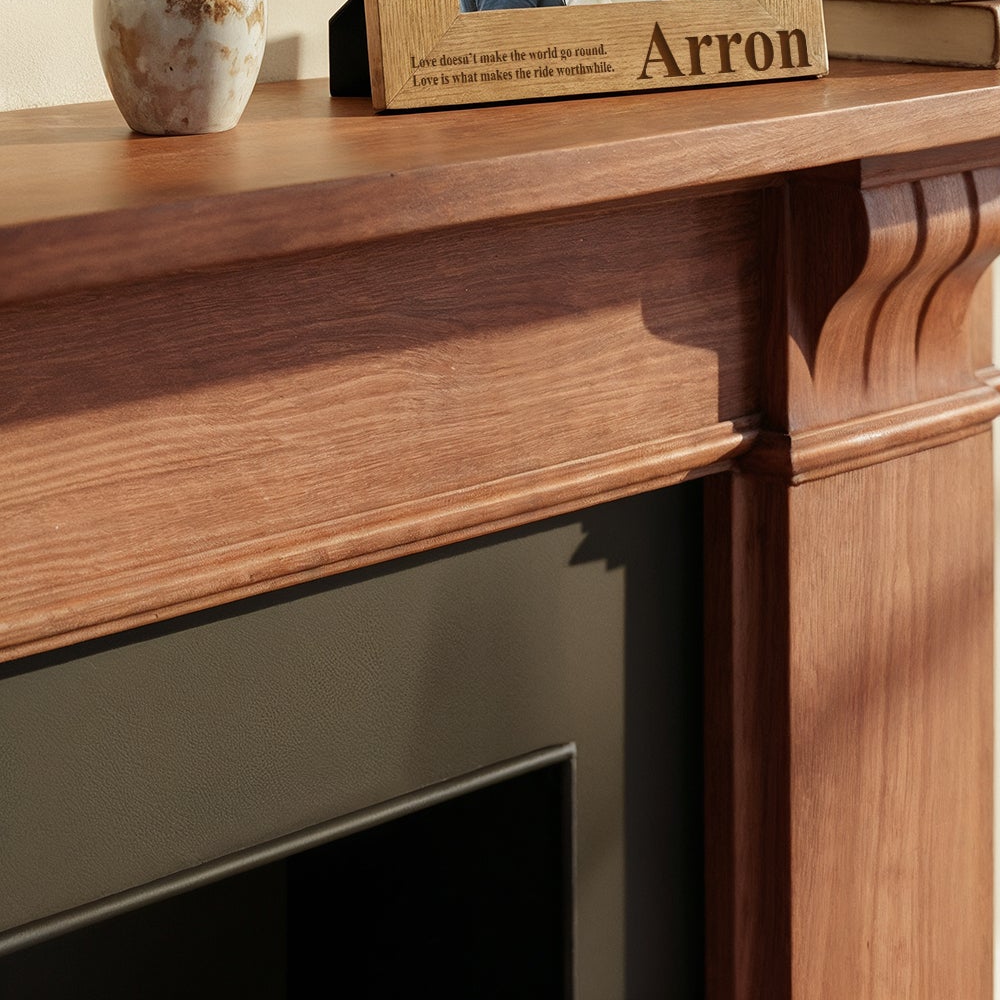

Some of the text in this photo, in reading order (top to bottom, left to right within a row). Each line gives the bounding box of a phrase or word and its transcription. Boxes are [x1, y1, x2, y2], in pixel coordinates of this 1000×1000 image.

[411, 44, 608, 68] Love doesn't make the world go round.
[637, 21, 812, 80] Arron
[413, 61, 615, 87] Love is what makes the ride worthwhile.
